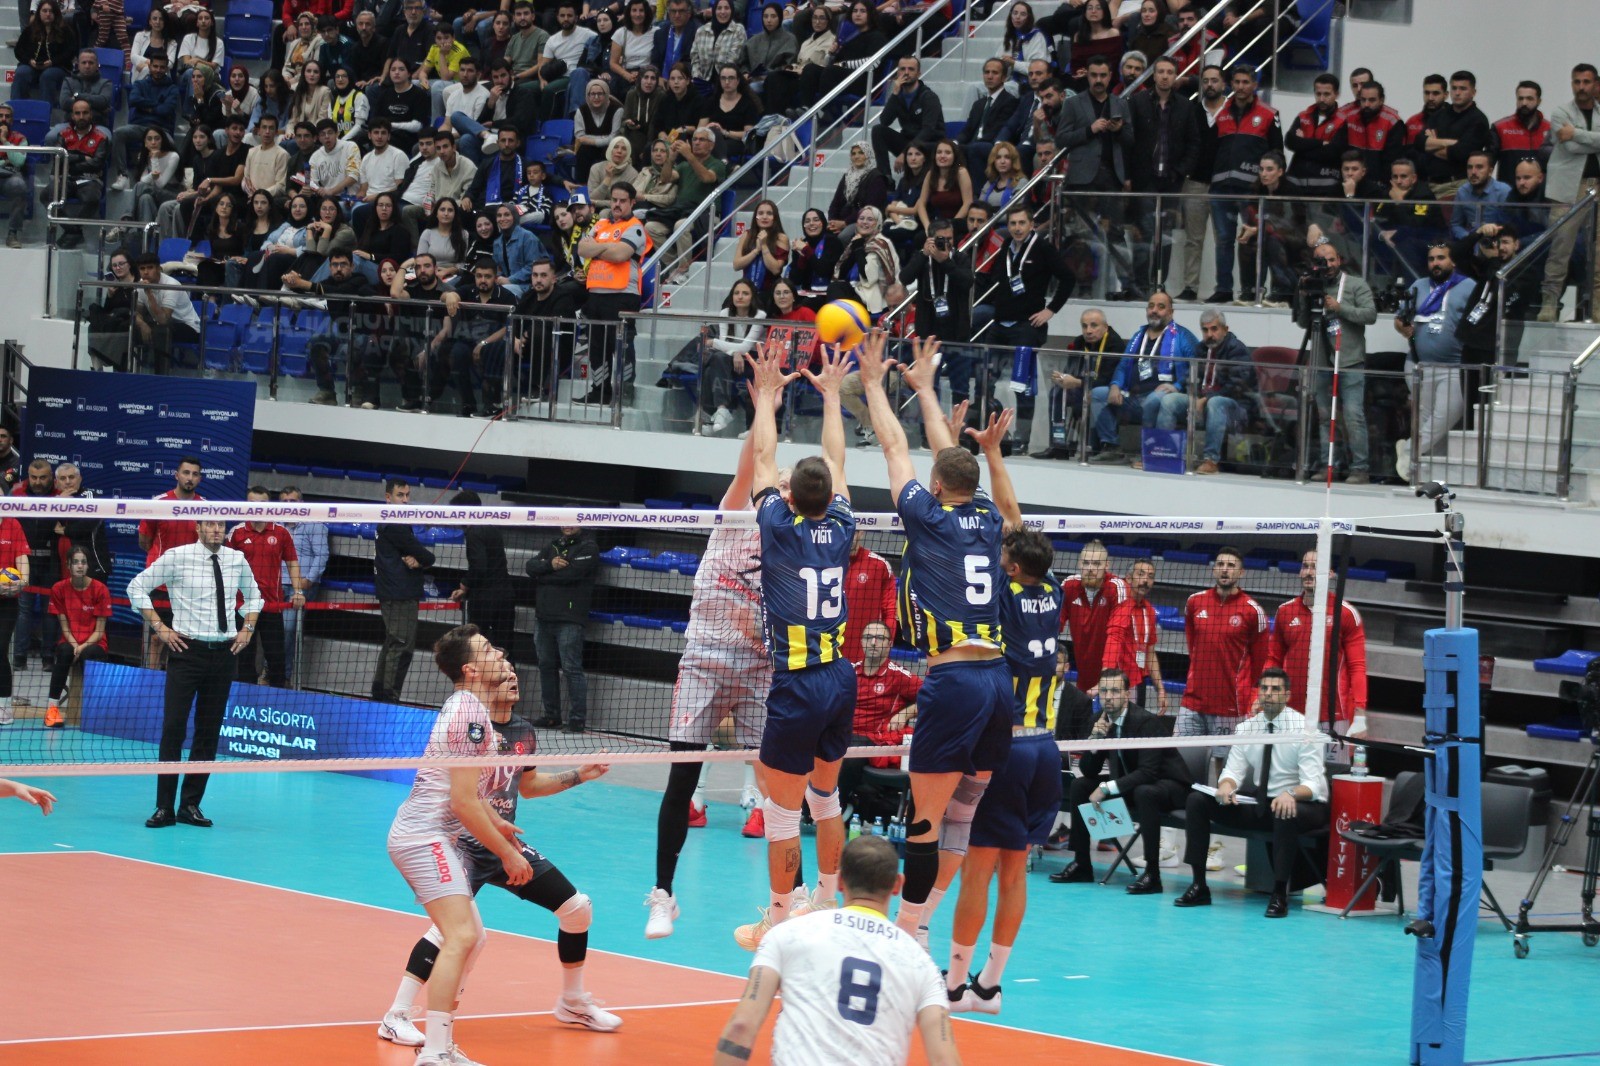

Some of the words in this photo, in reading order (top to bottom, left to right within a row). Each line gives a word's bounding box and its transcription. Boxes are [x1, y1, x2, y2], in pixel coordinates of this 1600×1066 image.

[201, 468, 234, 476] AMPİYONLAR
[50, 504, 98, 513] KUPASI
[172, 505, 264, 517] ŞAMPİYONLAR
[266, 507, 311, 517] KUPASI
[380, 509, 466, 520] ŞAMPİYONLAR
[468, 511, 511, 520] KUPASI
[576, 512, 656, 523] ŞAMPİYONLAR
[659, 515, 699, 523] KUPASI
[1099, 519, 1168, 531] ŞAMPİYONLAR
[1170, 521, 1204, 530] KUPASI
[1256, 520, 1319, 531] ŞAMPİYONLAR
[964, 555, 992, 605] 5
[799, 566, 843, 620] 13
[232, 705, 257, 721] AXA
[259, 707, 316, 730] SİGORTA
[219, 724, 317, 751] MPİYONLAR
[228, 741, 280, 759] KUPASI
[837, 955, 883, 1026] 8
